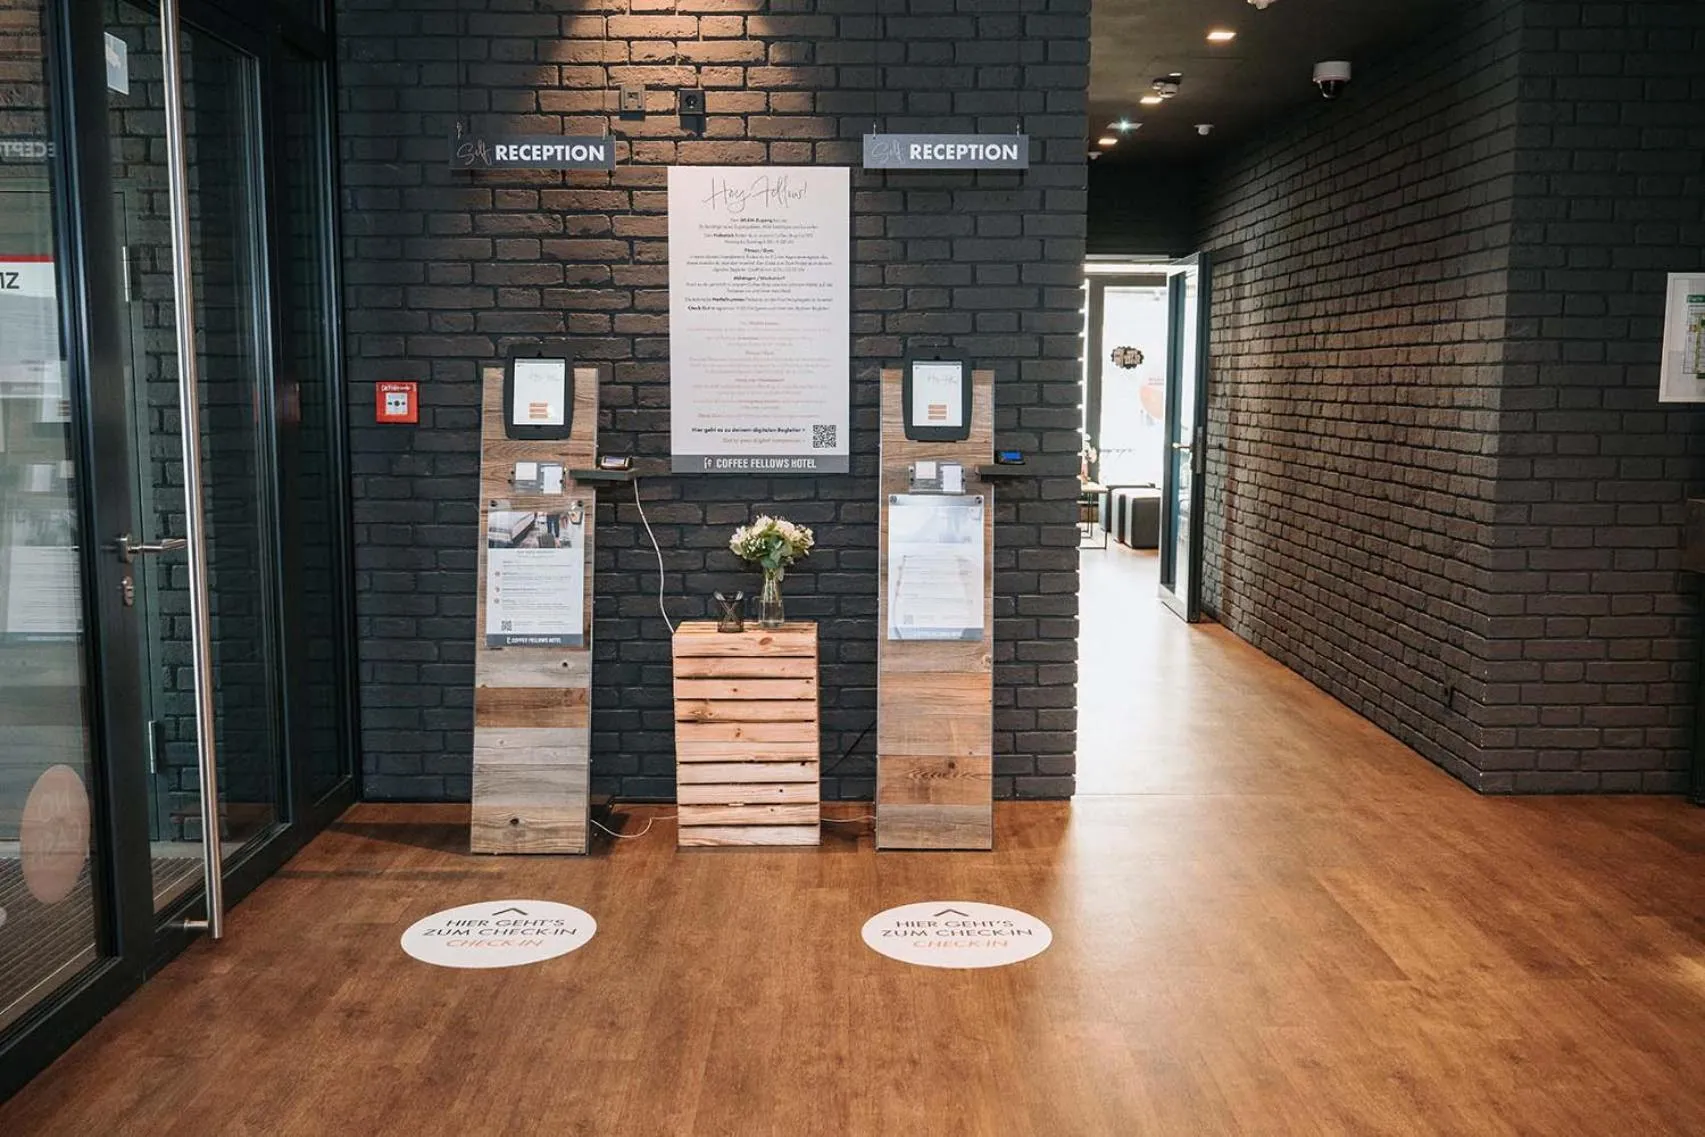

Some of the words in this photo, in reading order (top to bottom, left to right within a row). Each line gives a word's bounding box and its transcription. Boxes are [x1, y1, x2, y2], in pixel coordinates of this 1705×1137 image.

[495, 144, 605, 161] RECEPTION
[909, 143, 1018, 161] RECEPTION
[716, 458, 748, 469] COFFEE
[750, 458, 790, 469] FELLOWS
[791, 458, 817, 469] HOTEL
[446, 919, 489, 928] HIER
[495, 919, 566, 928] GEHT'S
[896, 920, 938, 928] HIER
[944, 920, 1014, 928] GEHT'S
[422, 928, 470, 937] ZUM
[881, 929, 928, 938] ZUM
